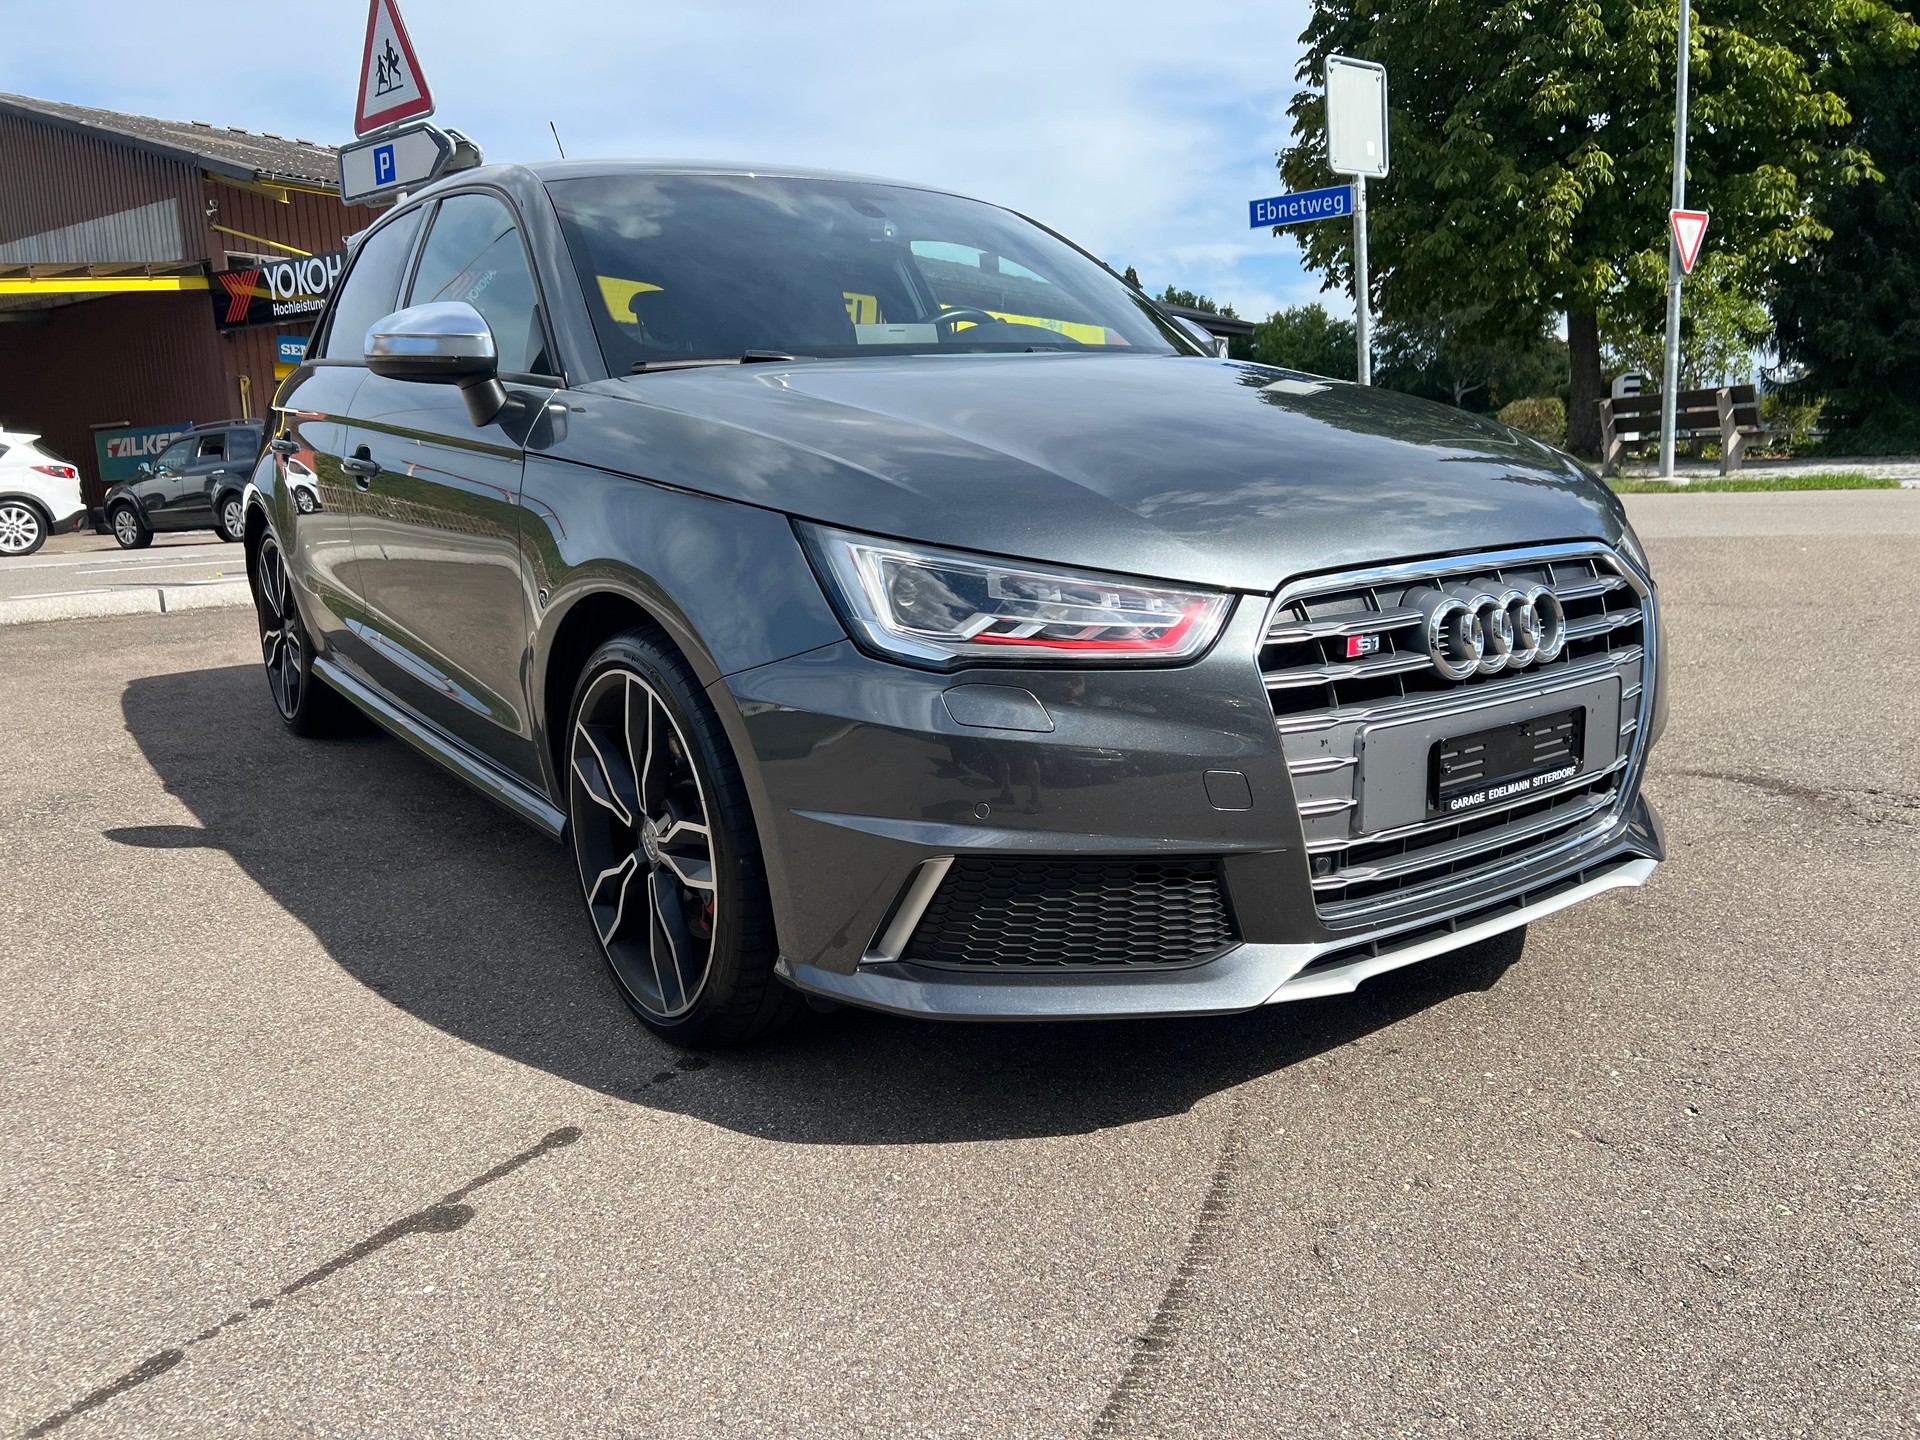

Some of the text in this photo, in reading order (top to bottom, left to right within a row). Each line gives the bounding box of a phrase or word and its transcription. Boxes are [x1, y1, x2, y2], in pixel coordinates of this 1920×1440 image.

[379, 152, 390, 180] P
[1256, 194, 1344, 221] Ebnetweg
[1356, 636, 1380, 652] S1
[1450, 765, 1577, 811] GARAGE EDELMANN SITTERDORF
